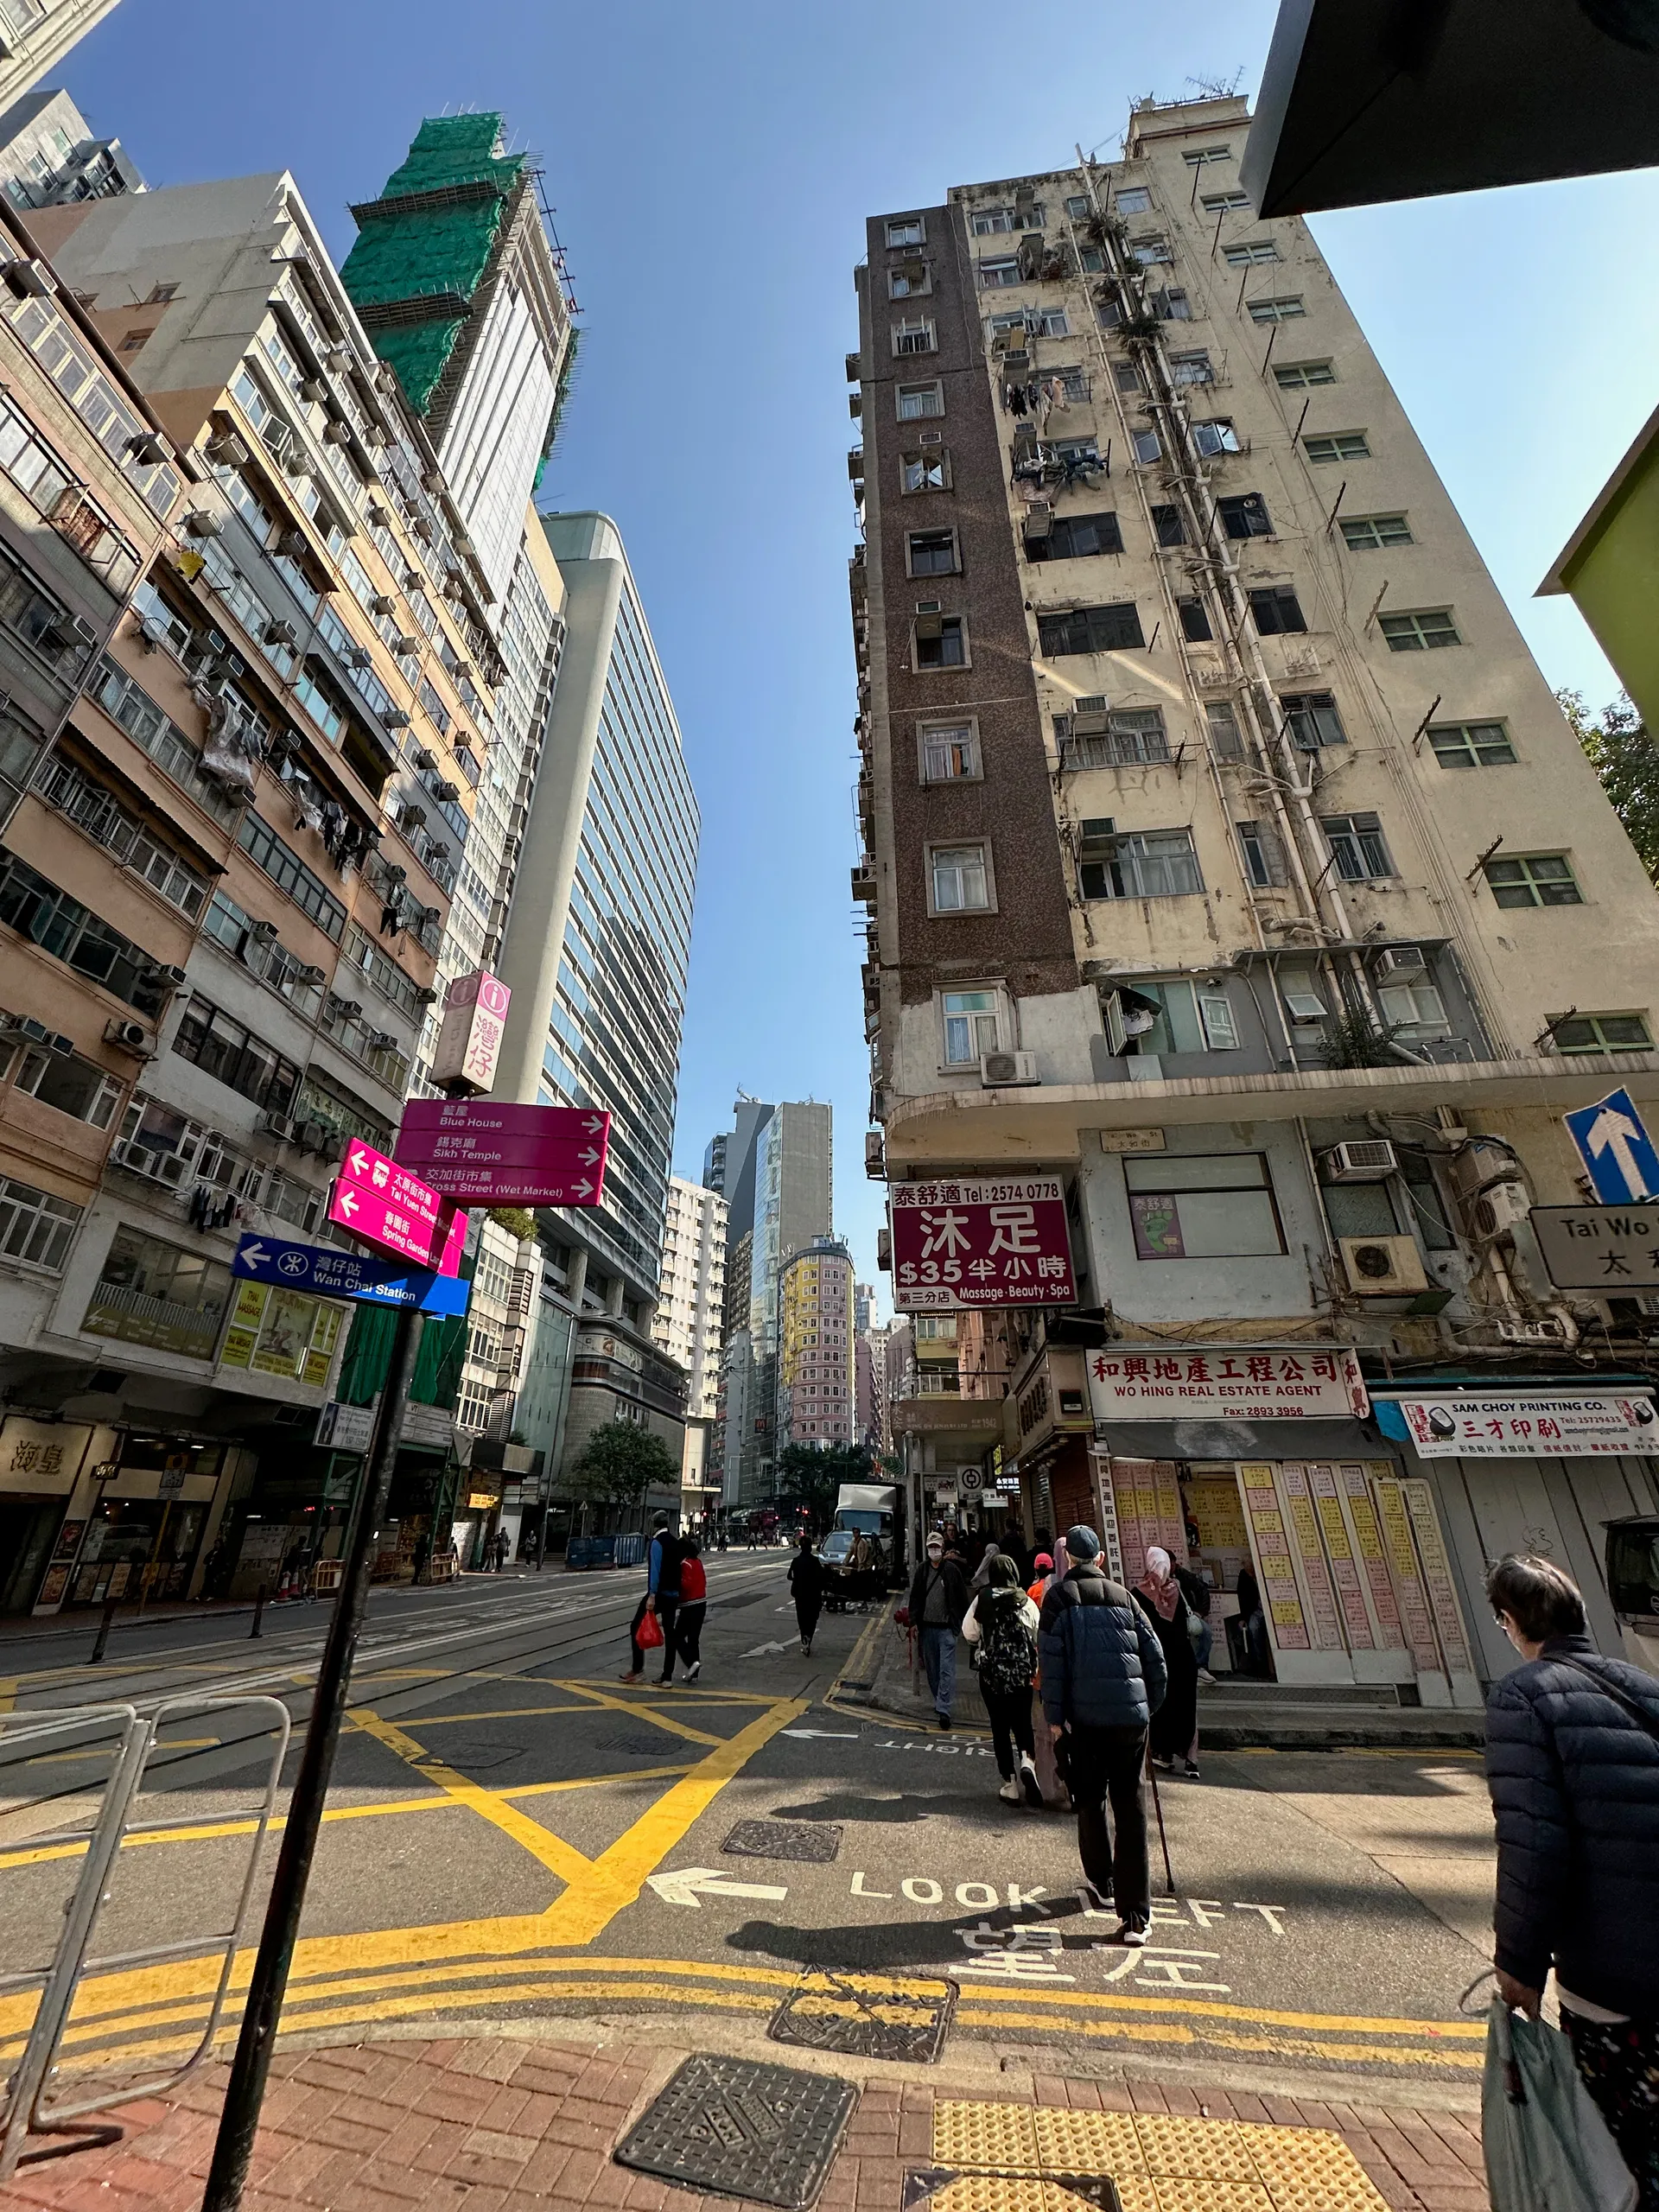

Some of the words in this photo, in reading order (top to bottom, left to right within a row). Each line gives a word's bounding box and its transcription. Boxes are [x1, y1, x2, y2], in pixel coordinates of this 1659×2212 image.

[468, 1014, 500, 1078] 灣仔
[440, 1116, 465, 1127] Blue
[467, 1118, 503, 1128] House
[434, 1148, 457, 1159] Sikh
[461, 1150, 502, 1161] Temple
[425, 1168, 493, 1182] 交加街市集
[393, 1173, 433, 1207] 太原街市集
[459, 1182, 493, 1193] Street
[495, 1185, 520, 1196] (Wet
[524, 1187, 563, 1198] Market)
[895, 1185, 962, 1206] 泰舒適
[992, 1185, 1024, 1201] 2574
[1027, 1183, 1059, 1199] 0778
[391, 1185, 403, 1202] Tai
[403, 1193, 421, 1213] Yuen
[419, 1205, 438, 1224] Street
[385, 1211, 411, 1236] 春園街
[919, 1205, 1041, 1258] 沐足
[1559, 1218, 1600, 1238] Tai
[1604, 1217, 1649, 1236] Wo
[382, 1225, 407, 1249] Spring
[406, 1238, 430, 1260] Garden
[429, 1250, 444, 1268] Lane
[315, 1255, 362, 1276] 灣仔站
[313, 1271, 341, 1287] Wan
[345, 1279, 373, 1293] Chai
[375, 1283, 416, 1301] Station
[959, 1285, 1003, 1301] Massage
[1008, 1282, 1045, 1298] Beauty
[1050, 1282, 1071, 1298] Spa
[899, 1291, 950, 1305] 第三分店
[1092, 1355, 1338, 1383] 和興地產工程公司
[1115, 1386, 1136, 1397] WO
[1141, 1386, 1174, 1397] HING
[1179, 1386, 1215, 1397] REAL
[1219, 1385, 1271, 1396] ESTATE
[1275, 1385, 1322, 1396] AGENT
[1223, 1407, 1244, 1415] Fax:
[1246, 1407, 1274, 1416] 2893
[1276, 1406, 1304, 1416] 3956
[1452, 1403, 1479, 1413] SAM
[1482, 1402, 1516, 1412] CHOY
[1521, 1402, 1581, 1412] PRINTING
[1584, 1402, 1606, 1410] CO.
[1462, 1417, 1561, 1440] 三才印刷
[849, 1871, 1052, 1916] LOOK
[1076, 1887, 1286, 1935] LEFT
[948, 1922, 1232, 1993] 望左
